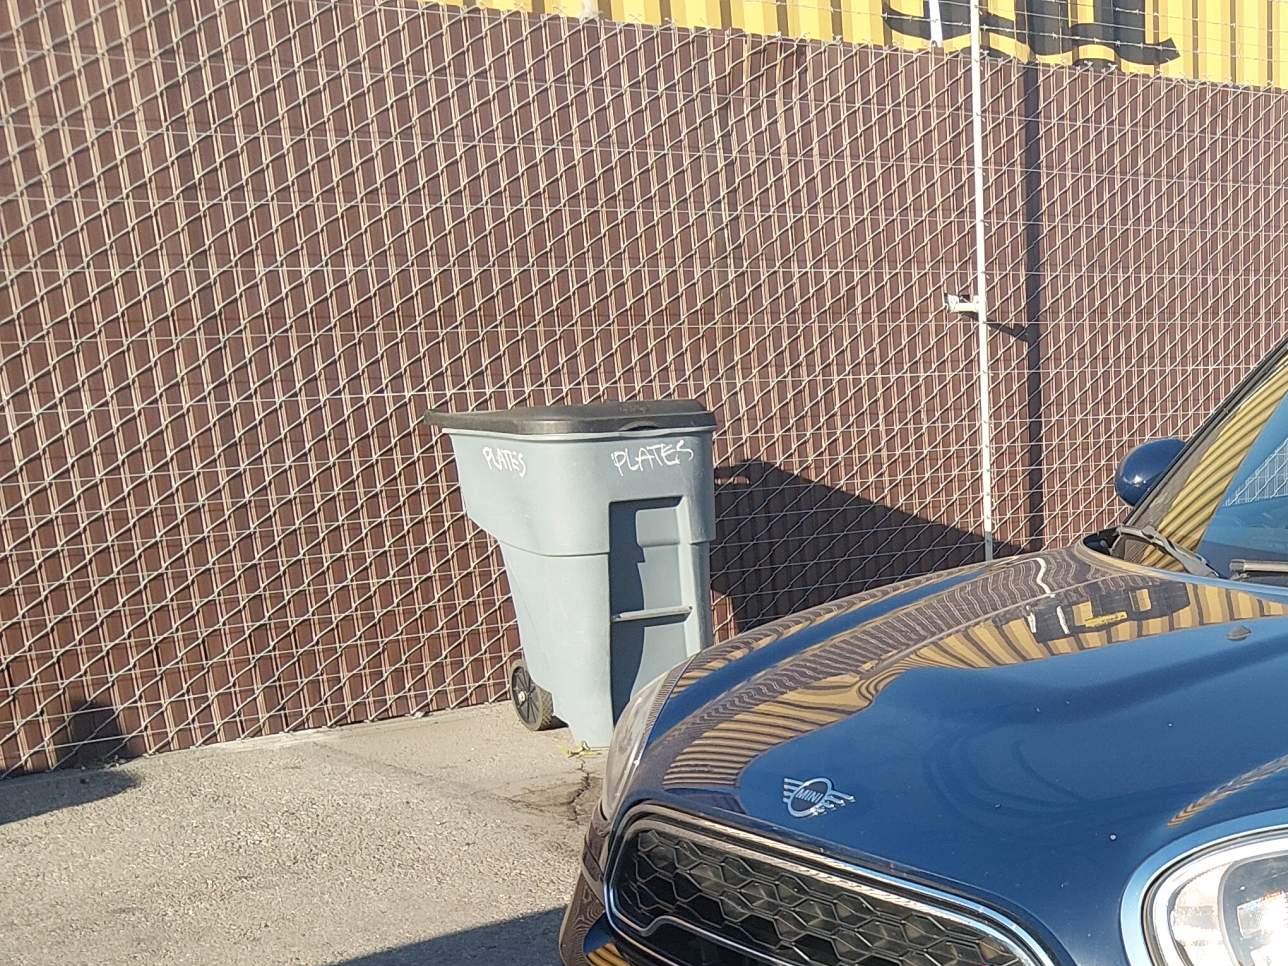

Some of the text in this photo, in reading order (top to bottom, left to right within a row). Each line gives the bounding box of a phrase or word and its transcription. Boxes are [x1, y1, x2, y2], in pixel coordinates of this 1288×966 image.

[482, 446, 526, 477] PLATES
[611, 440, 694, 476] PLATES
[796, 787, 824, 804] MINI
